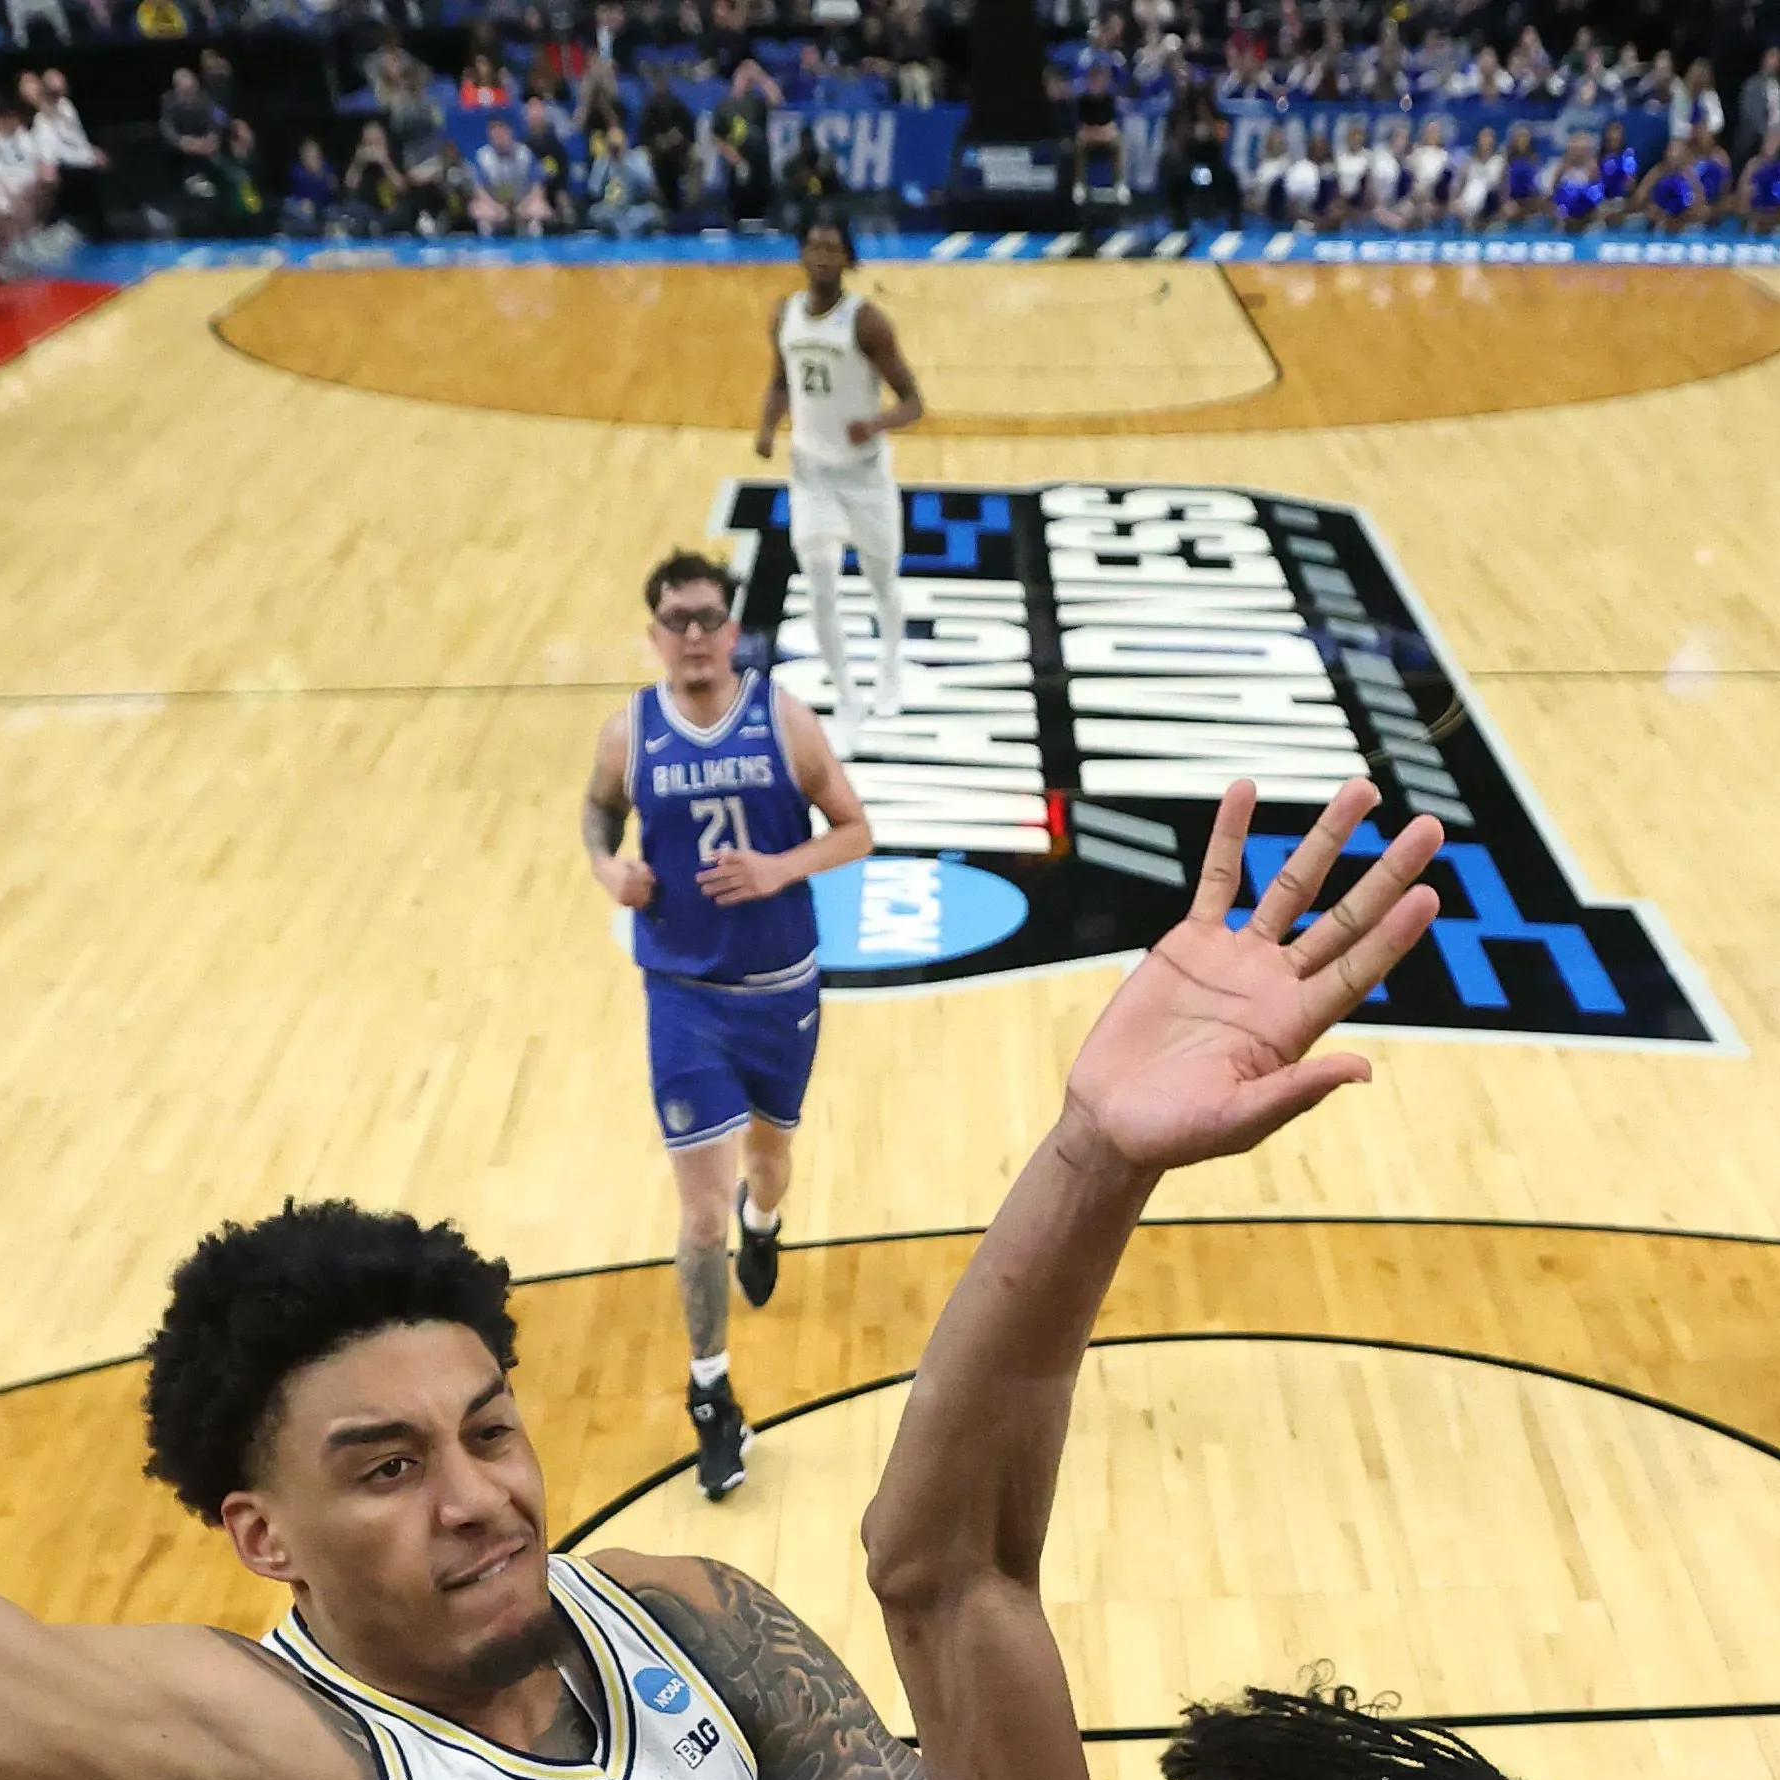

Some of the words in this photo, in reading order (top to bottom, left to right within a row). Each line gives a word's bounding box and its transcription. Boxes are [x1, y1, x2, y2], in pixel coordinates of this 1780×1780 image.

[1039, 484, 1383, 805] MADNESS
[770, 573, 1052, 855] MARCH
[689, 795, 752, 866] 21
[857, 858, 942, 955] NCAA
[652, 1676, 685, 1709] NCAA
